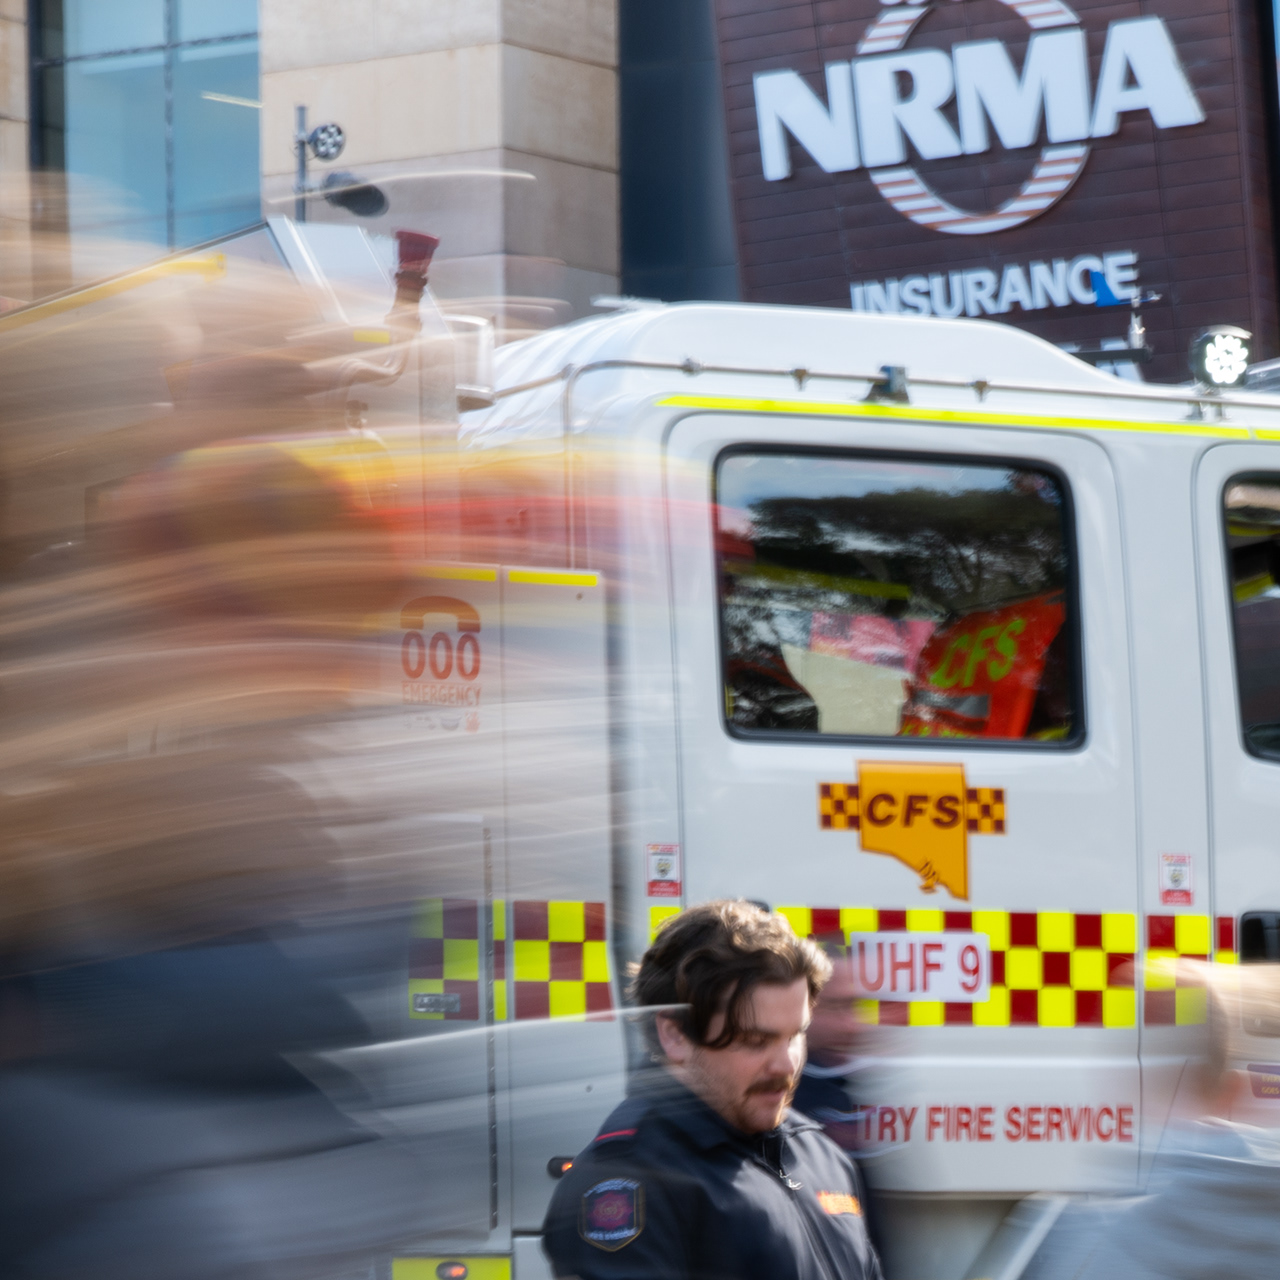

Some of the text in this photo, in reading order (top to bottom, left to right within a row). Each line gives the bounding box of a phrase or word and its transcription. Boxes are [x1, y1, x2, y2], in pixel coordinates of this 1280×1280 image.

[752, 14, 1207, 182] NRMA
[850, 250, 1139, 318] INSURANCE
[401, 630, 481, 681] 000
[931, 619, 1024, 688] CFS
[401, 681, 481, 707] EMERGENCY
[865, 792, 963, 828] CFS
[857, 940, 981, 994] UHF 9
[855, 1104, 1134, 1143] TRY FIRE SERVICE
